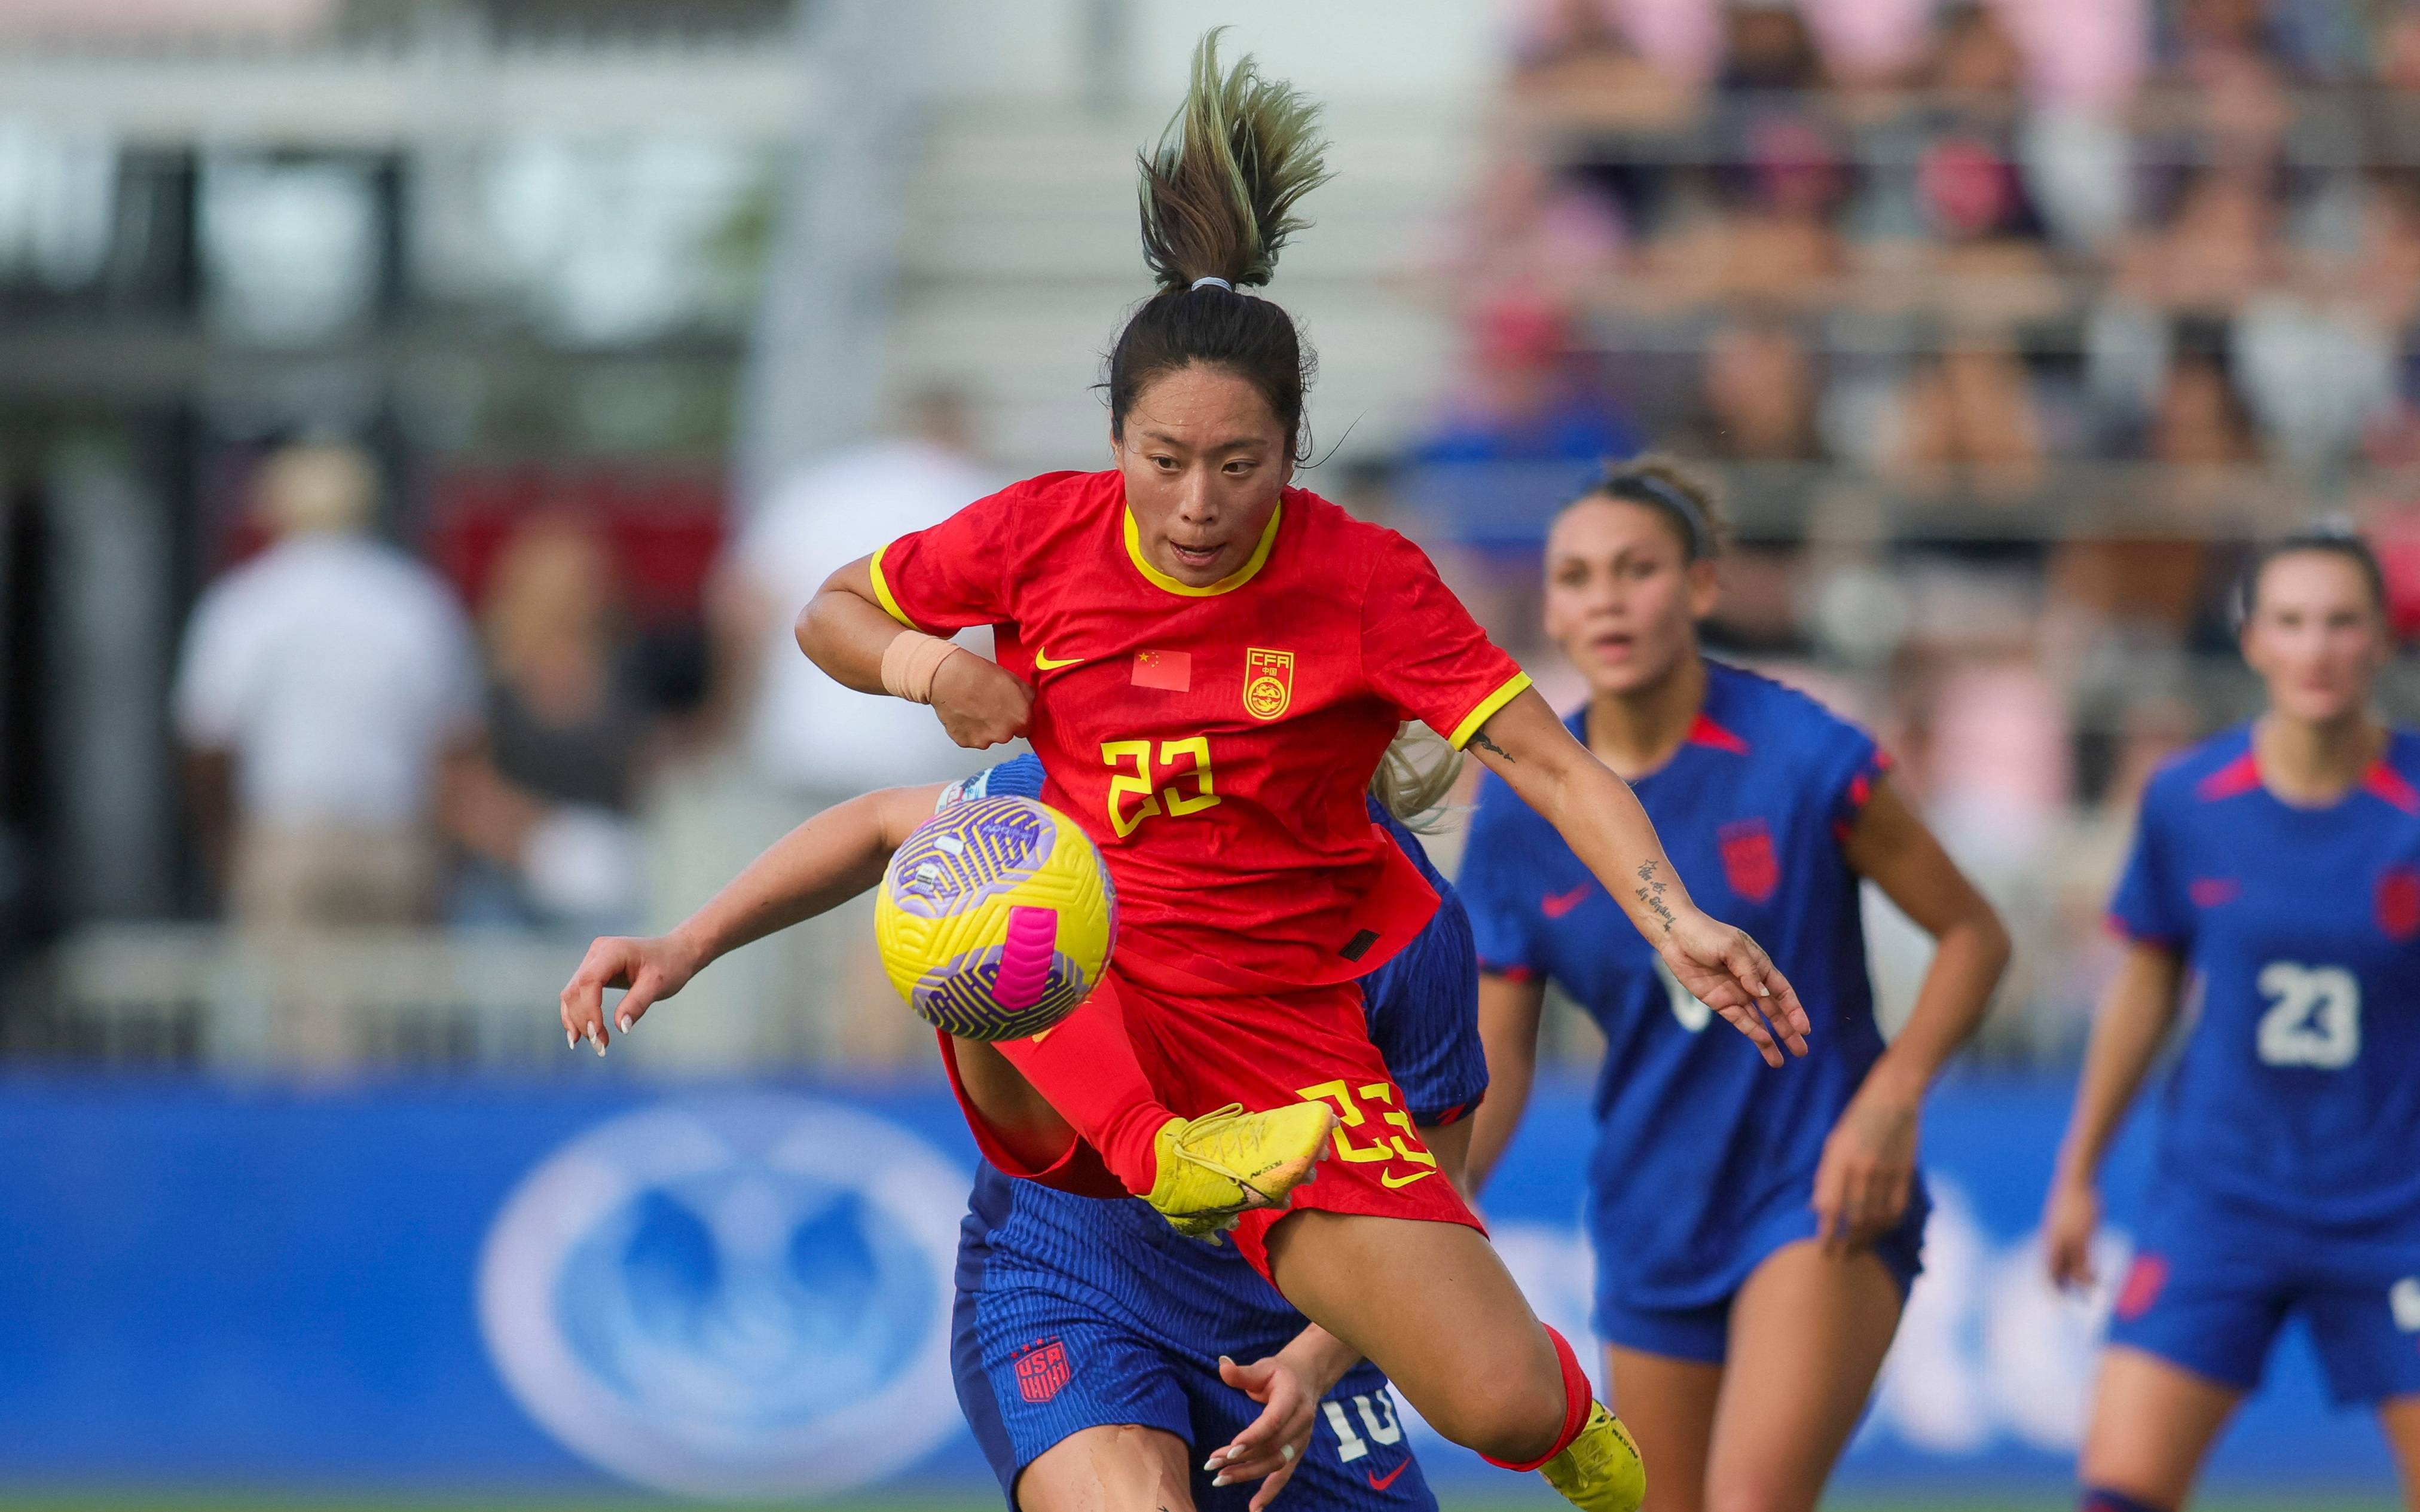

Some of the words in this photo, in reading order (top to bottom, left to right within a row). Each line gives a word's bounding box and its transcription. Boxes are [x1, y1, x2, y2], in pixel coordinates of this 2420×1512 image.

[1251, 653, 1290, 669] CFA
[1262, 666, 1278, 677] 中国
[1100, 736, 1221, 838] 23
[2256, 960, 2360, 1070] 23
[1294, 1079, 1437, 1168] 23
[1018, 1348, 1061, 1377] USA
